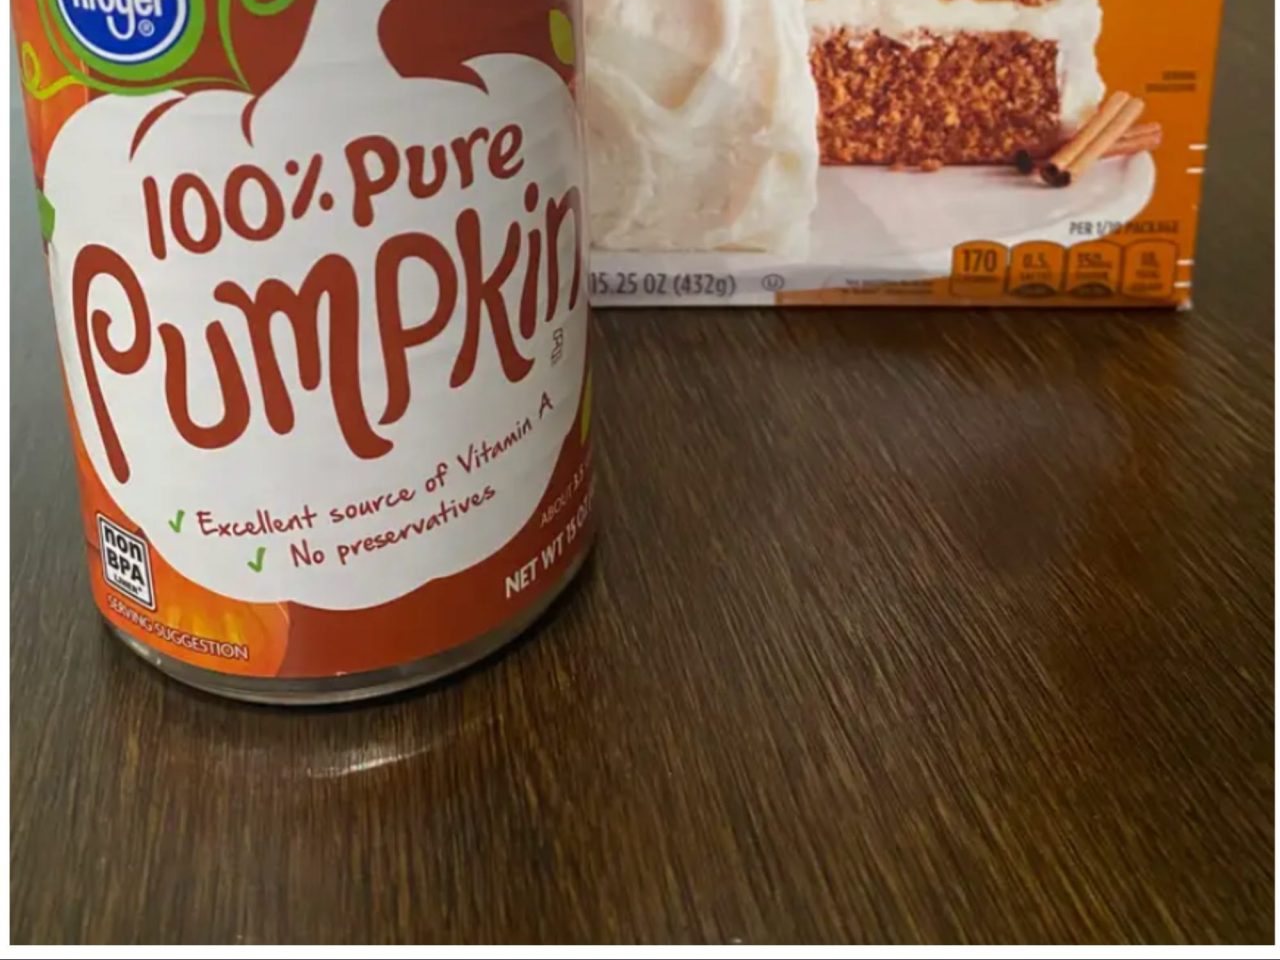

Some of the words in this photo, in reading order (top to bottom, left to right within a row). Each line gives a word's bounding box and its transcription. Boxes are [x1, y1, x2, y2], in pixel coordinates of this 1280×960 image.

[142, 152, 335, 261] 100%
[1069, 221, 1093, 235] PER
[643, 273, 668, 295] OZ
[673, 273, 736, 299] (432g)
[963, 249, 998, 274] 170
[196, 504, 318, 538] Excellent
[330, 487, 416, 524] source
[424, 462, 449, 494] of
[456, 421, 532, 474] Vitamin
[538, 391, 554, 419] A
[104, 525, 143, 562] non
[290, 542, 325, 568] No
[336, 484, 496, 566] preservatives
[106, 547, 145, 586] BPA
[505, 556, 539, 600] NET
[540, 530, 564, 571] WT
[108, 594, 153, 633] SERVING
[154, 622, 249, 660] SUGGESTION
